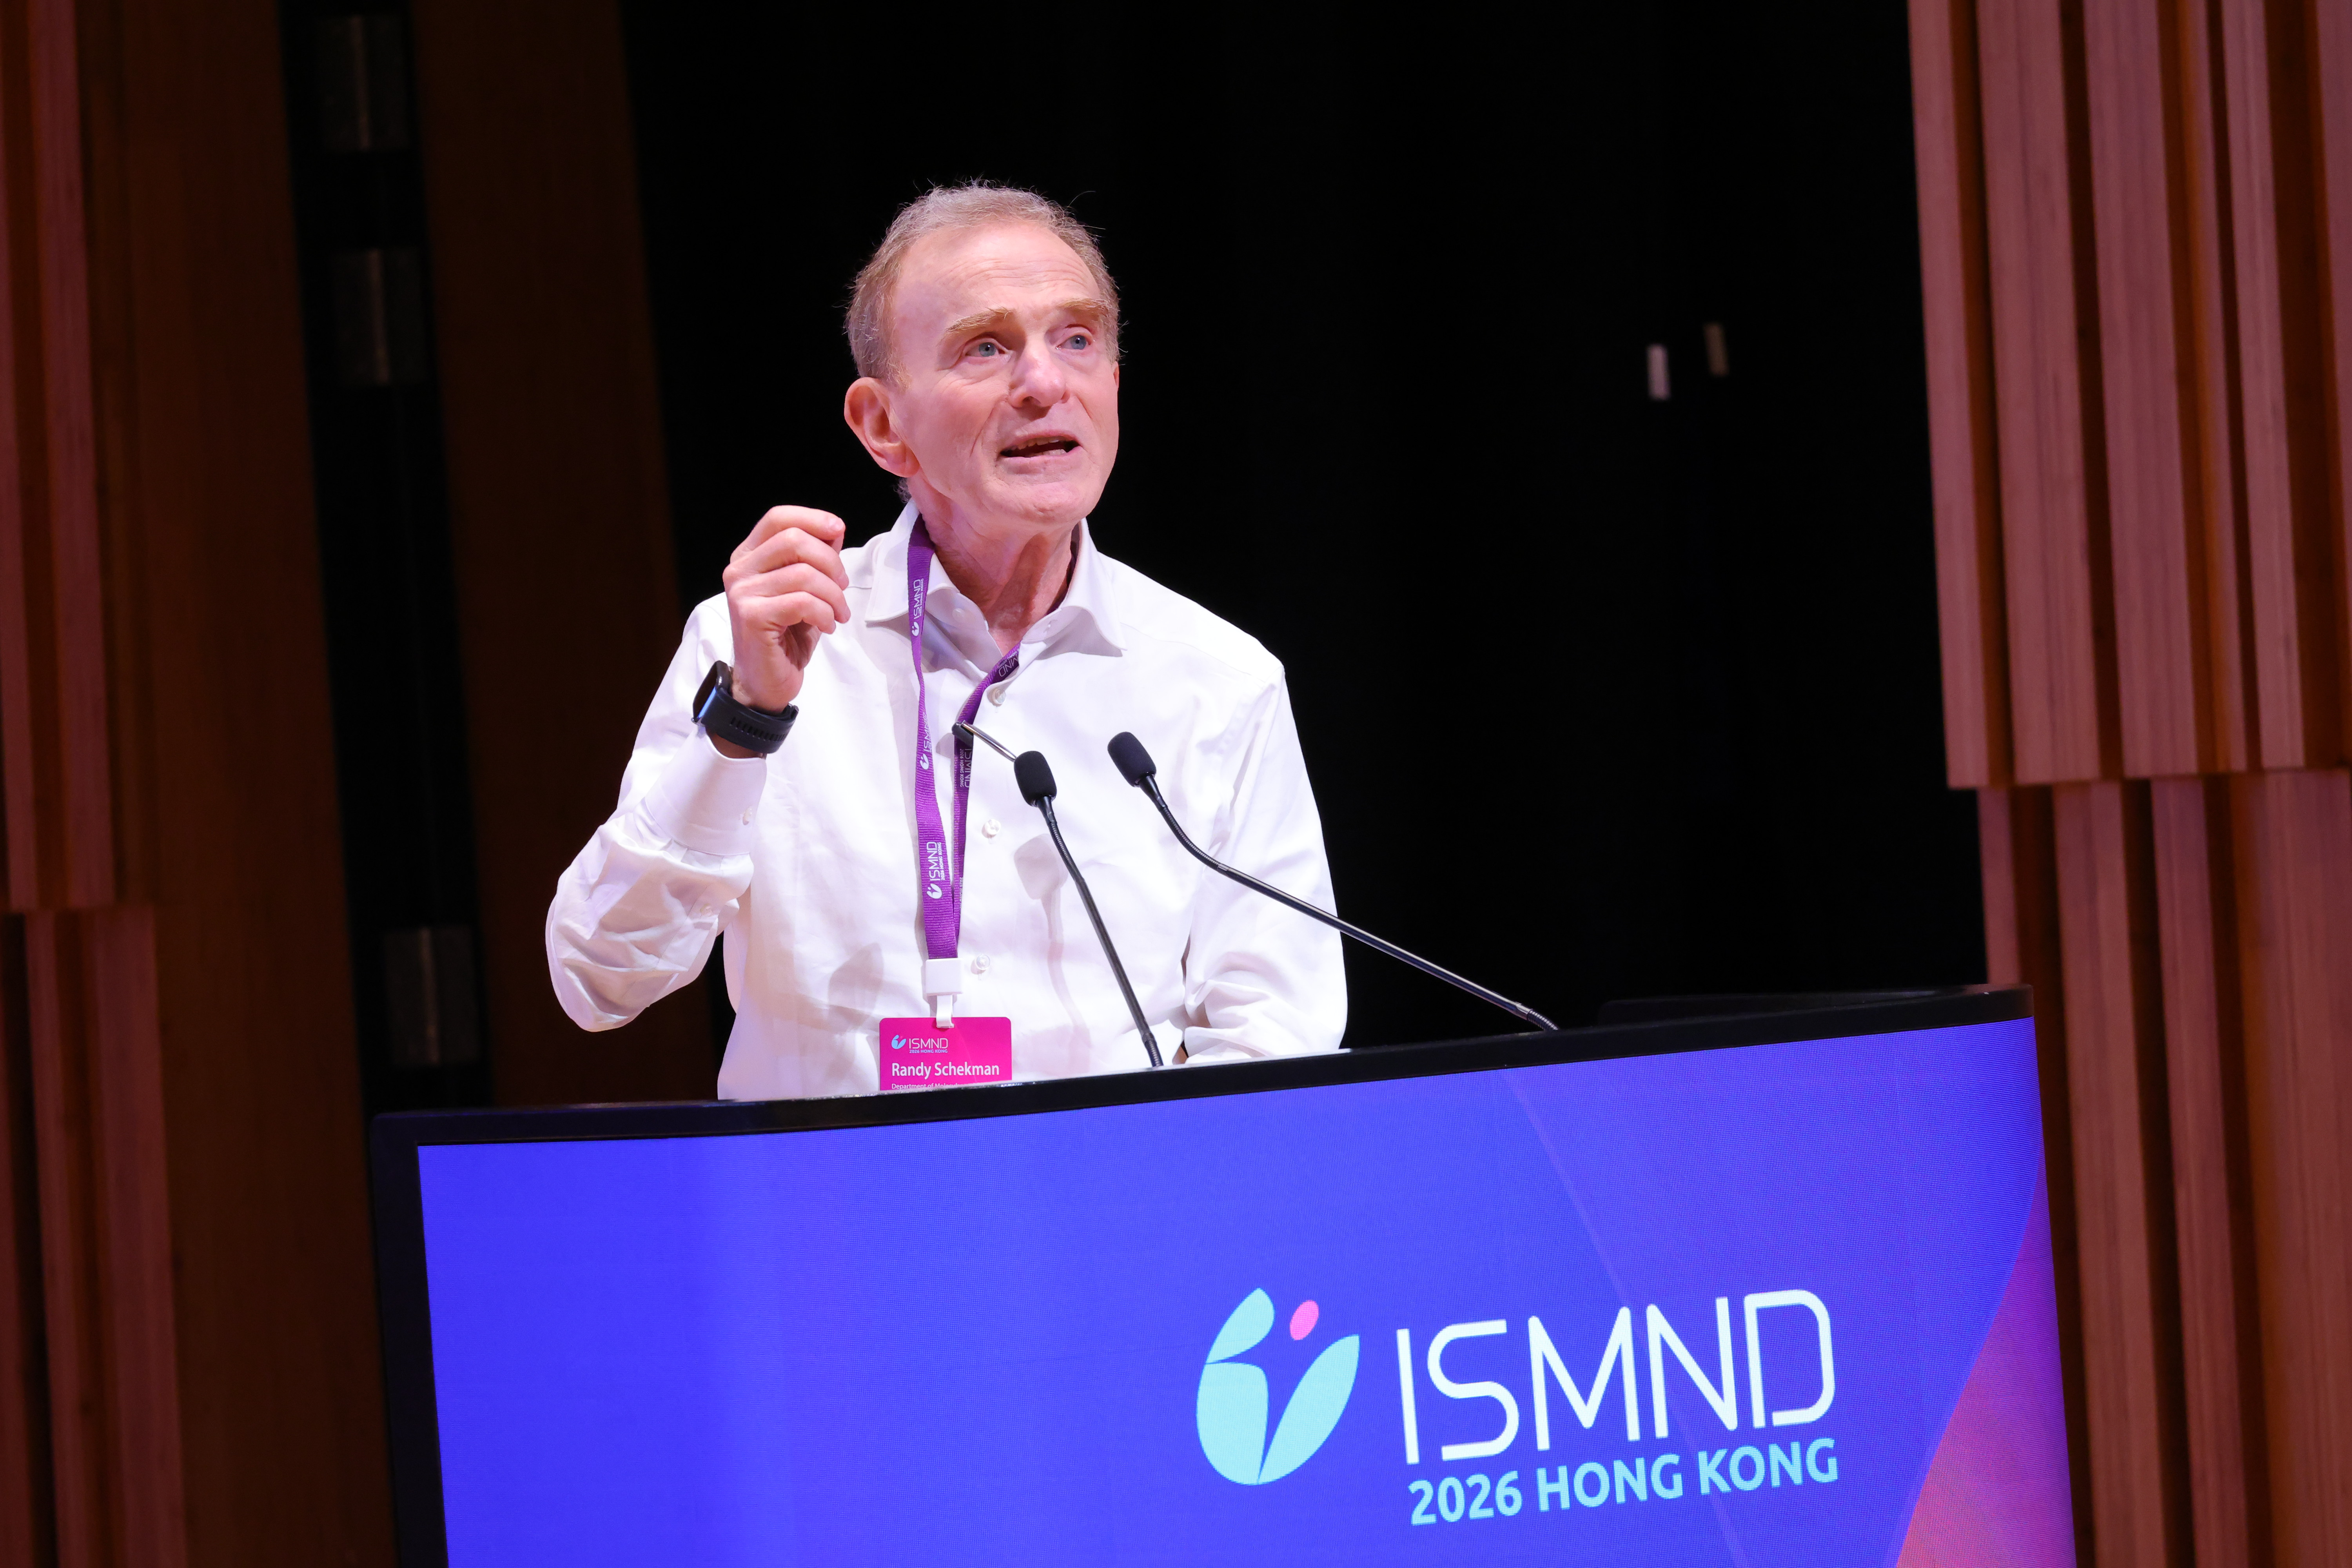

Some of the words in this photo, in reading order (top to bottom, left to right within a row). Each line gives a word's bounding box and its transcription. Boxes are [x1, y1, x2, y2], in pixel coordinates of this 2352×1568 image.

[999, 654, 1018, 677] MND
[1007, 651, 1017, 660] HONG
[926, 842, 941, 881] ISMND
[909, 1038, 948, 1049] ISMND
[892, 1062, 931, 1079] Randy
[935, 1062, 999, 1076] Schekman
[1396, 1289, 1835, 1465] ISMND
[1408, 1470, 1523, 1526] 2026
[1536, 1454, 1684, 1512] HONG
[1698, 1437, 1839, 1496] KONG
